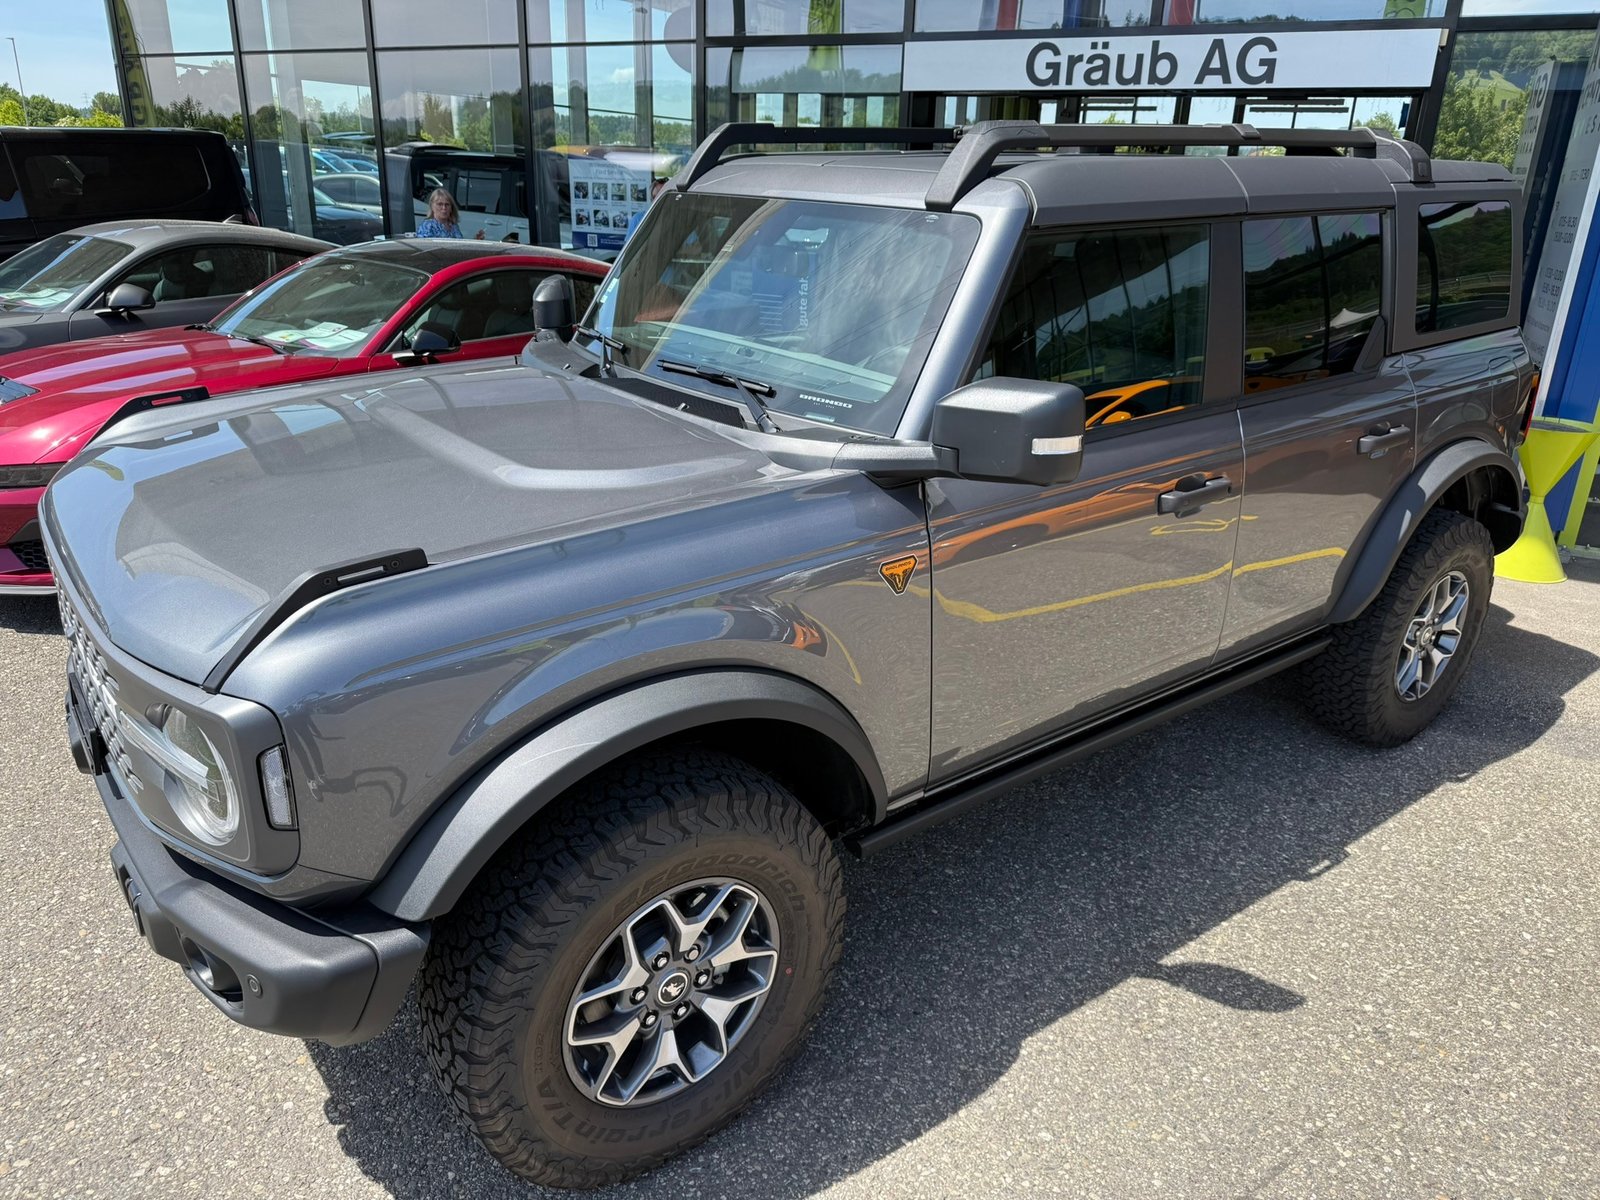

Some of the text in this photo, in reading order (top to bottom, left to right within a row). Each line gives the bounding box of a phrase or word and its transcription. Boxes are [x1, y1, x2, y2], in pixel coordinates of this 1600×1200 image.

[1026, 36, 1278, 86] Gräub AG
[799, 394, 853, 409] BRONCO
